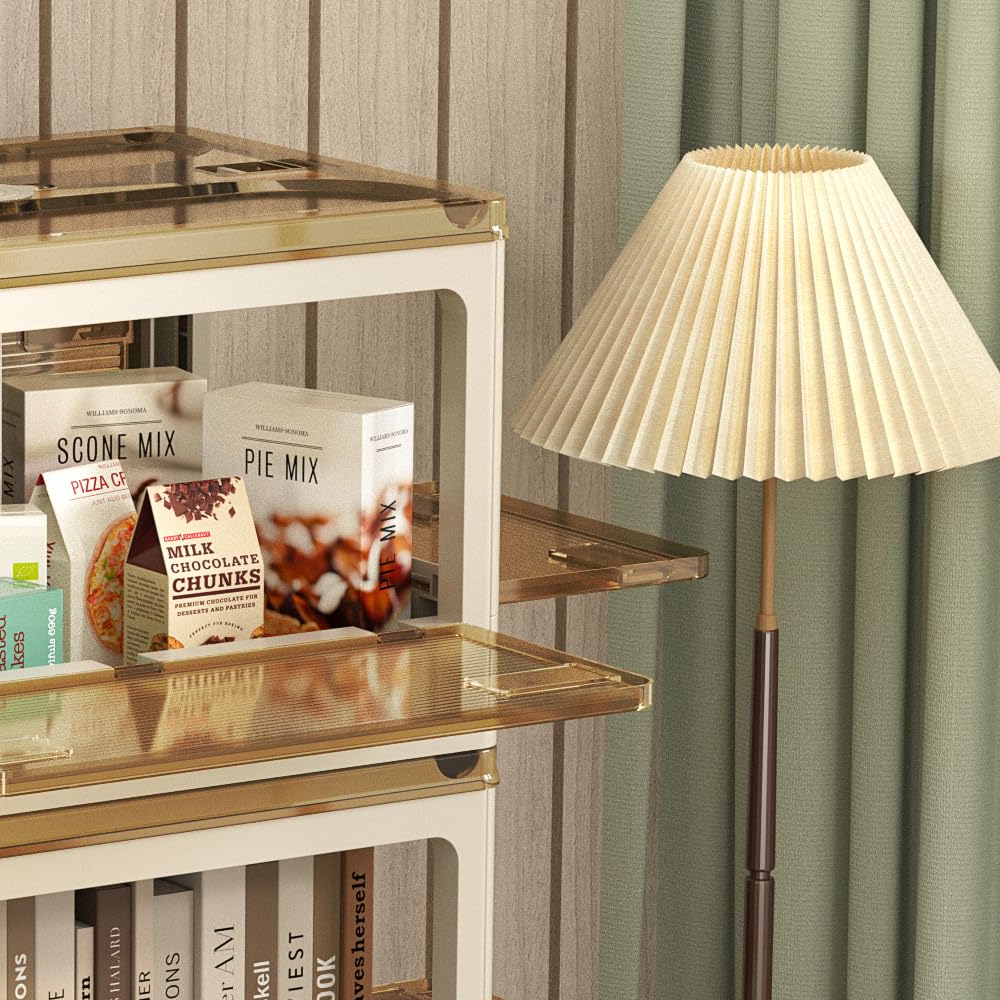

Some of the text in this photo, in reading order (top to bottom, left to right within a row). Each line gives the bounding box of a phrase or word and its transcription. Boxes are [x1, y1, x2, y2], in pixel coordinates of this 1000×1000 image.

[57, 430, 176, 465] SCONE MIX
[3, 456, 14, 498] MIX
[245, 448, 319, 485] PIE MIX
[71, 475, 110, 495] PIZZA
[166, 542, 215, 559] MILK
[170, 553, 260, 574] CHOCOLATE
[379, 500, 397, 592] PIE MIX
[172, 568, 261, 593] CHUNKS
[174, 600, 205, 609] PREMIUM
[206, 595, 244, 605] CHOCOLATE
[177, 607, 209, 617] DESSERTS
[225, 602, 256, 611] PASTRIES
[47, 607, 57, 666] lfuls 690g
[351, 872, 366, 954] herself
[109, 926, 120, 992] HALARD
[213, 923, 235, 976] AM
